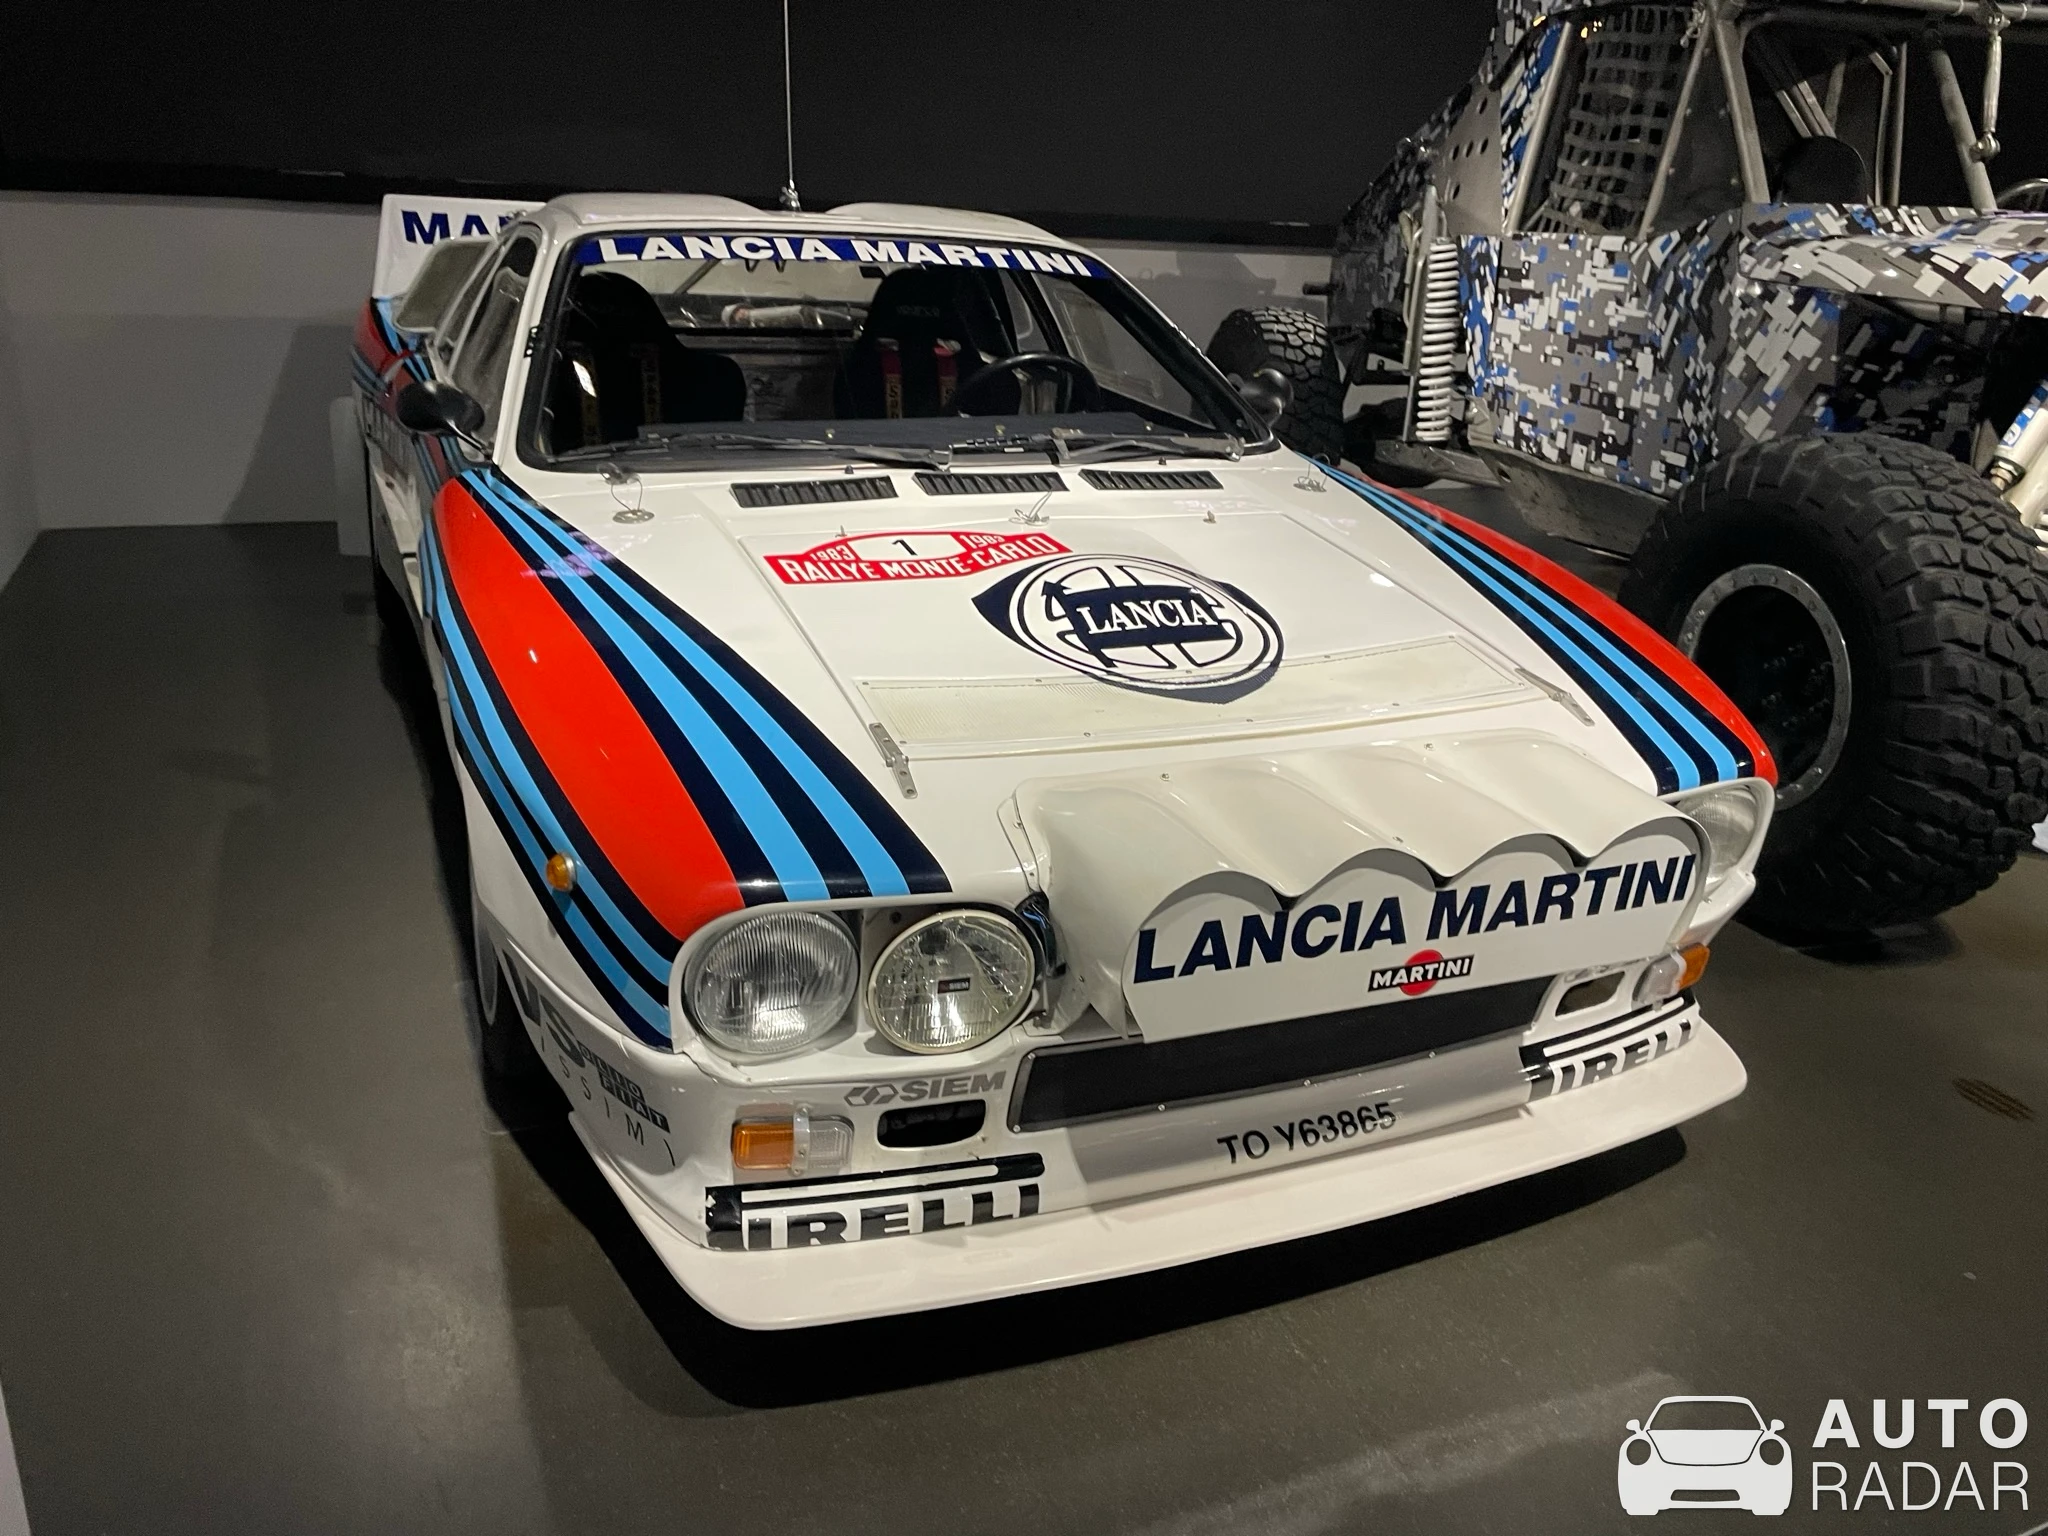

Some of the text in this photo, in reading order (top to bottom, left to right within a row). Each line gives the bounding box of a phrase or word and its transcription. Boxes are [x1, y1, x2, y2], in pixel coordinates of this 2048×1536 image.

[401, 209, 510, 245] MA
[599, 236, 1093, 277] LANCIA MARTINI
[809, 544, 856, 561] 1983
[891, 538, 919, 557] 1
[959, 534, 1006, 549] 1983
[778, 557, 881, 583] RALLYE
[1076, 599, 1219, 635] LANCIA
[1133, 854, 1697, 984] LANCIA MARTINI
[1371, 957, 1471, 989] MARTINI
[601, 1074, 669, 1132] FIAT
[899, 1070, 1007, 1102] SIEM
[1216, 1101, 1397, 1164] TO Y63865
